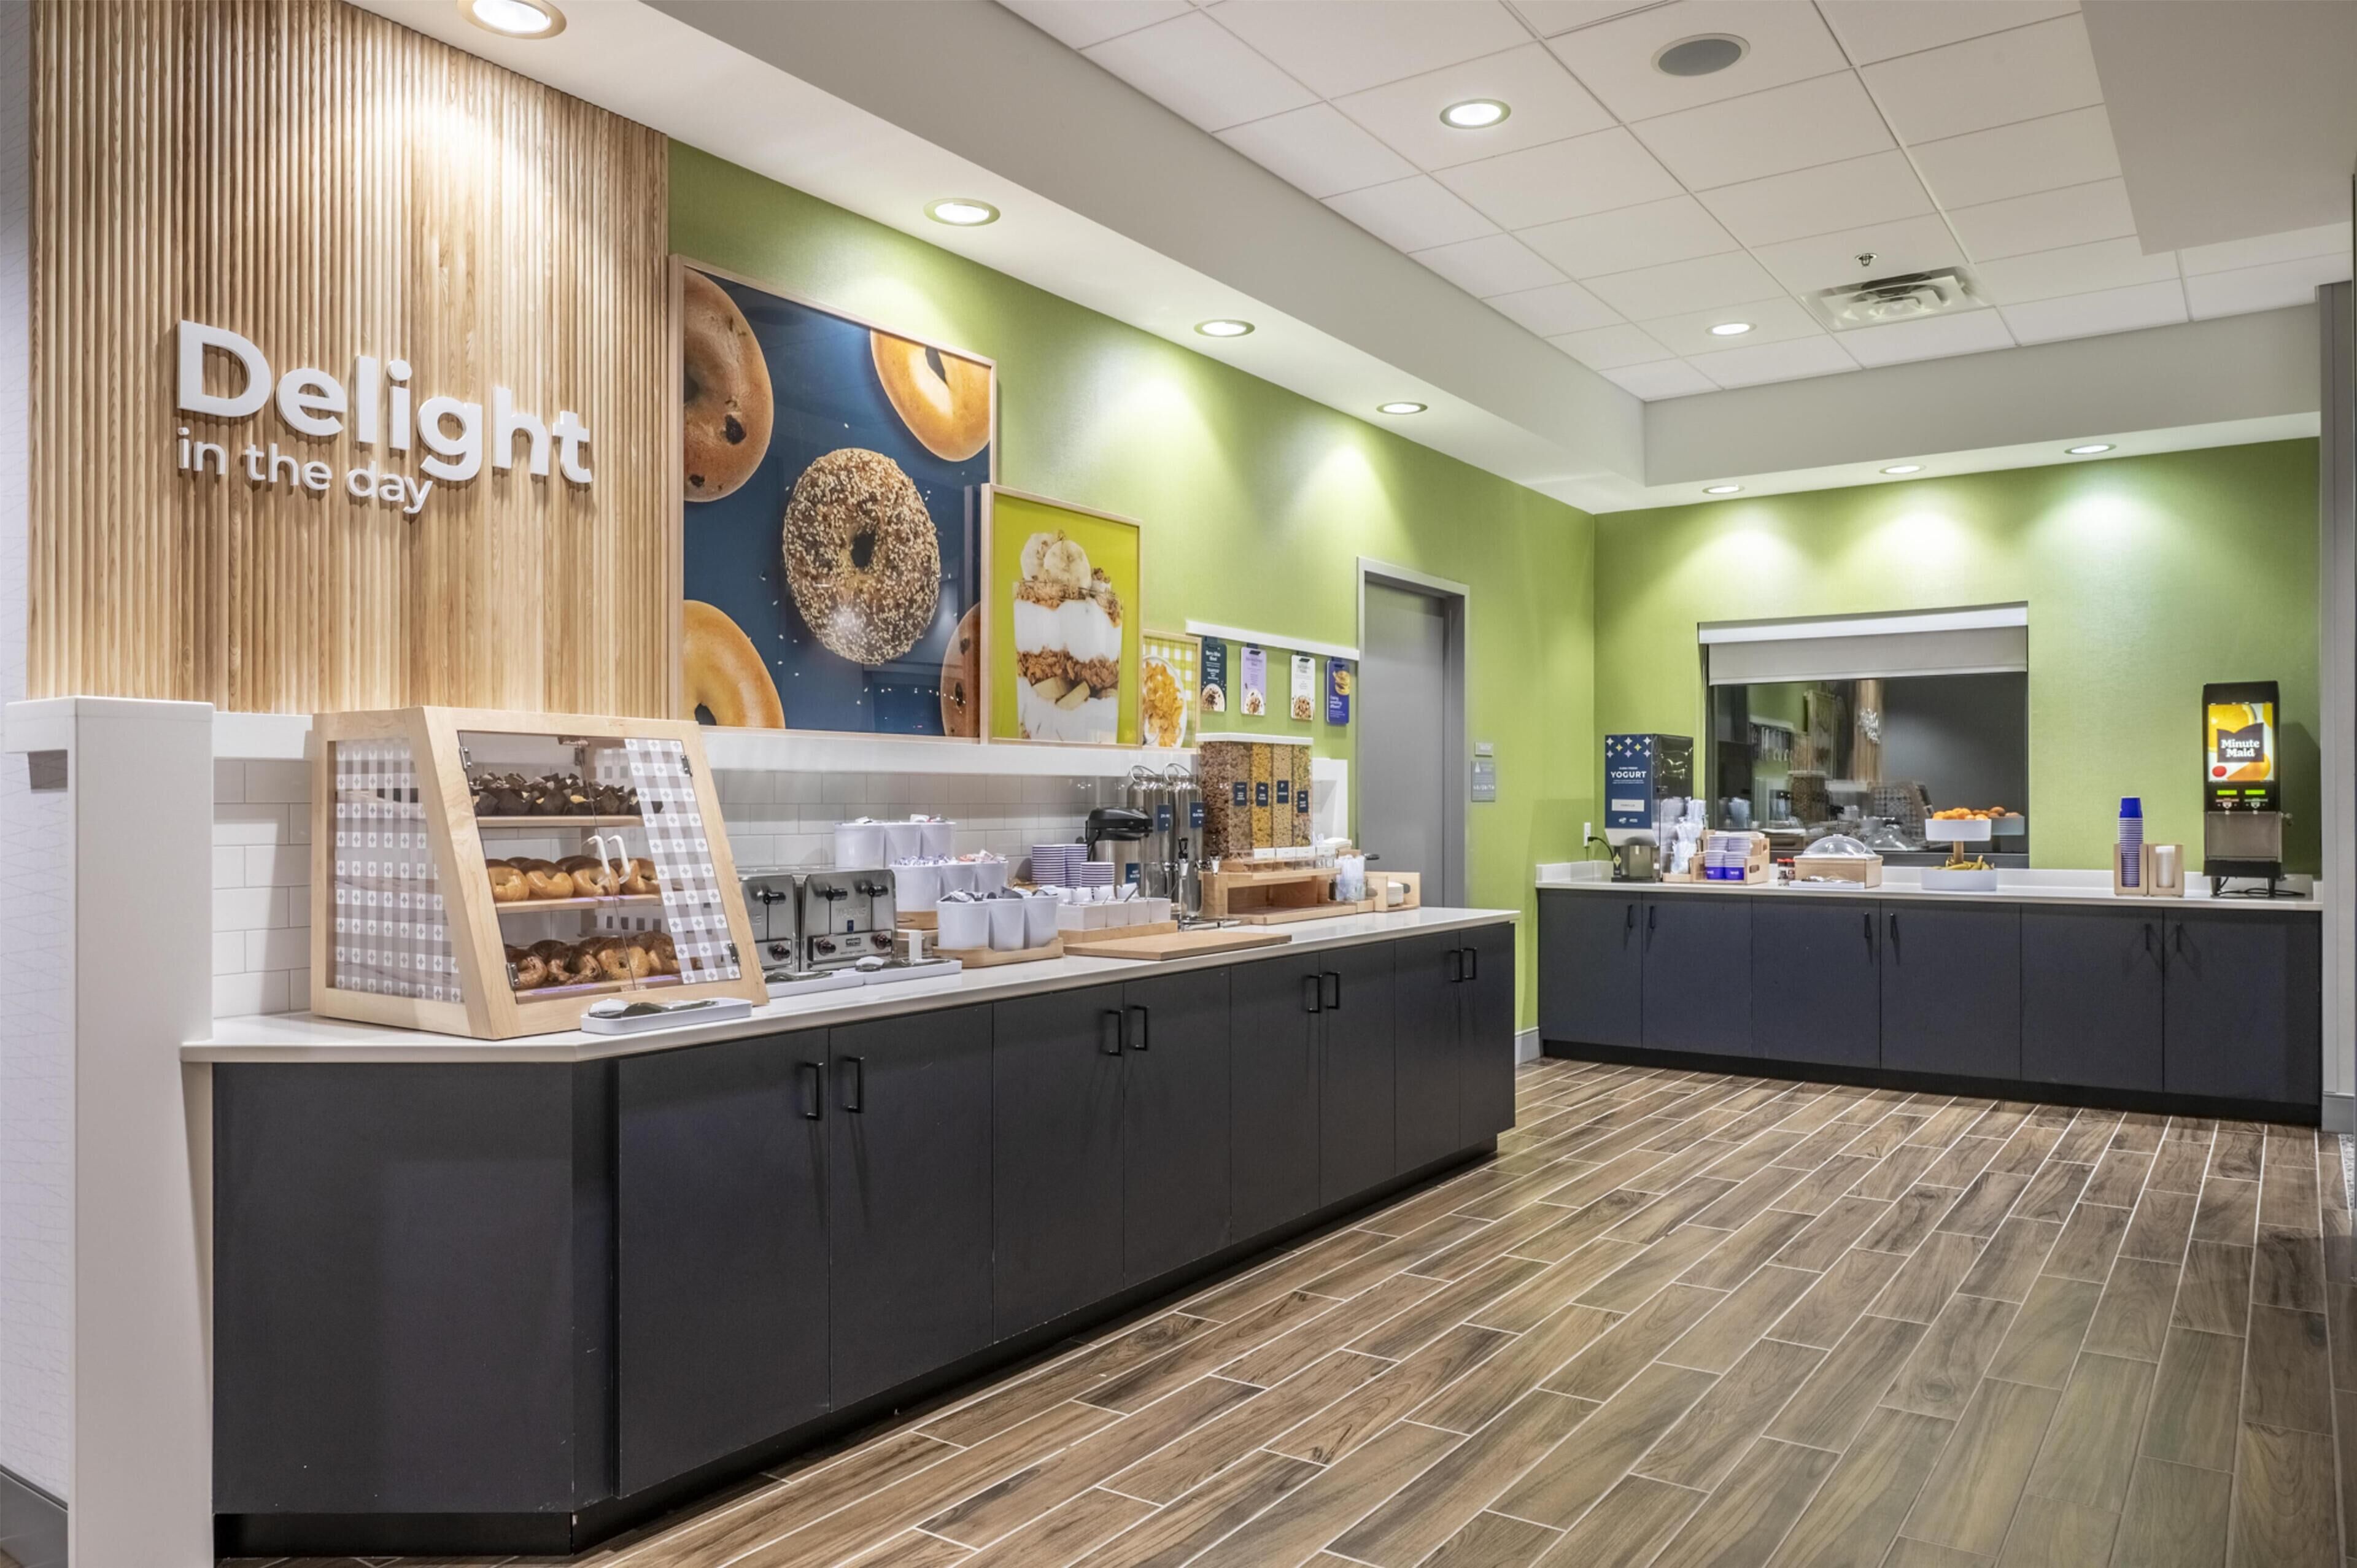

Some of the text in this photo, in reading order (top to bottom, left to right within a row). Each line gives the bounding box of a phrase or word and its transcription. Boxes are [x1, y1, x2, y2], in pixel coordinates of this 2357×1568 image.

[177, 319, 593, 484] Delight
[177, 427, 433, 514] in the day
[2220, 739, 2260, 749] Minute
[2226, 747, 2256, 758] Maid
[1610, 770, 1647, 779] YOGURT
